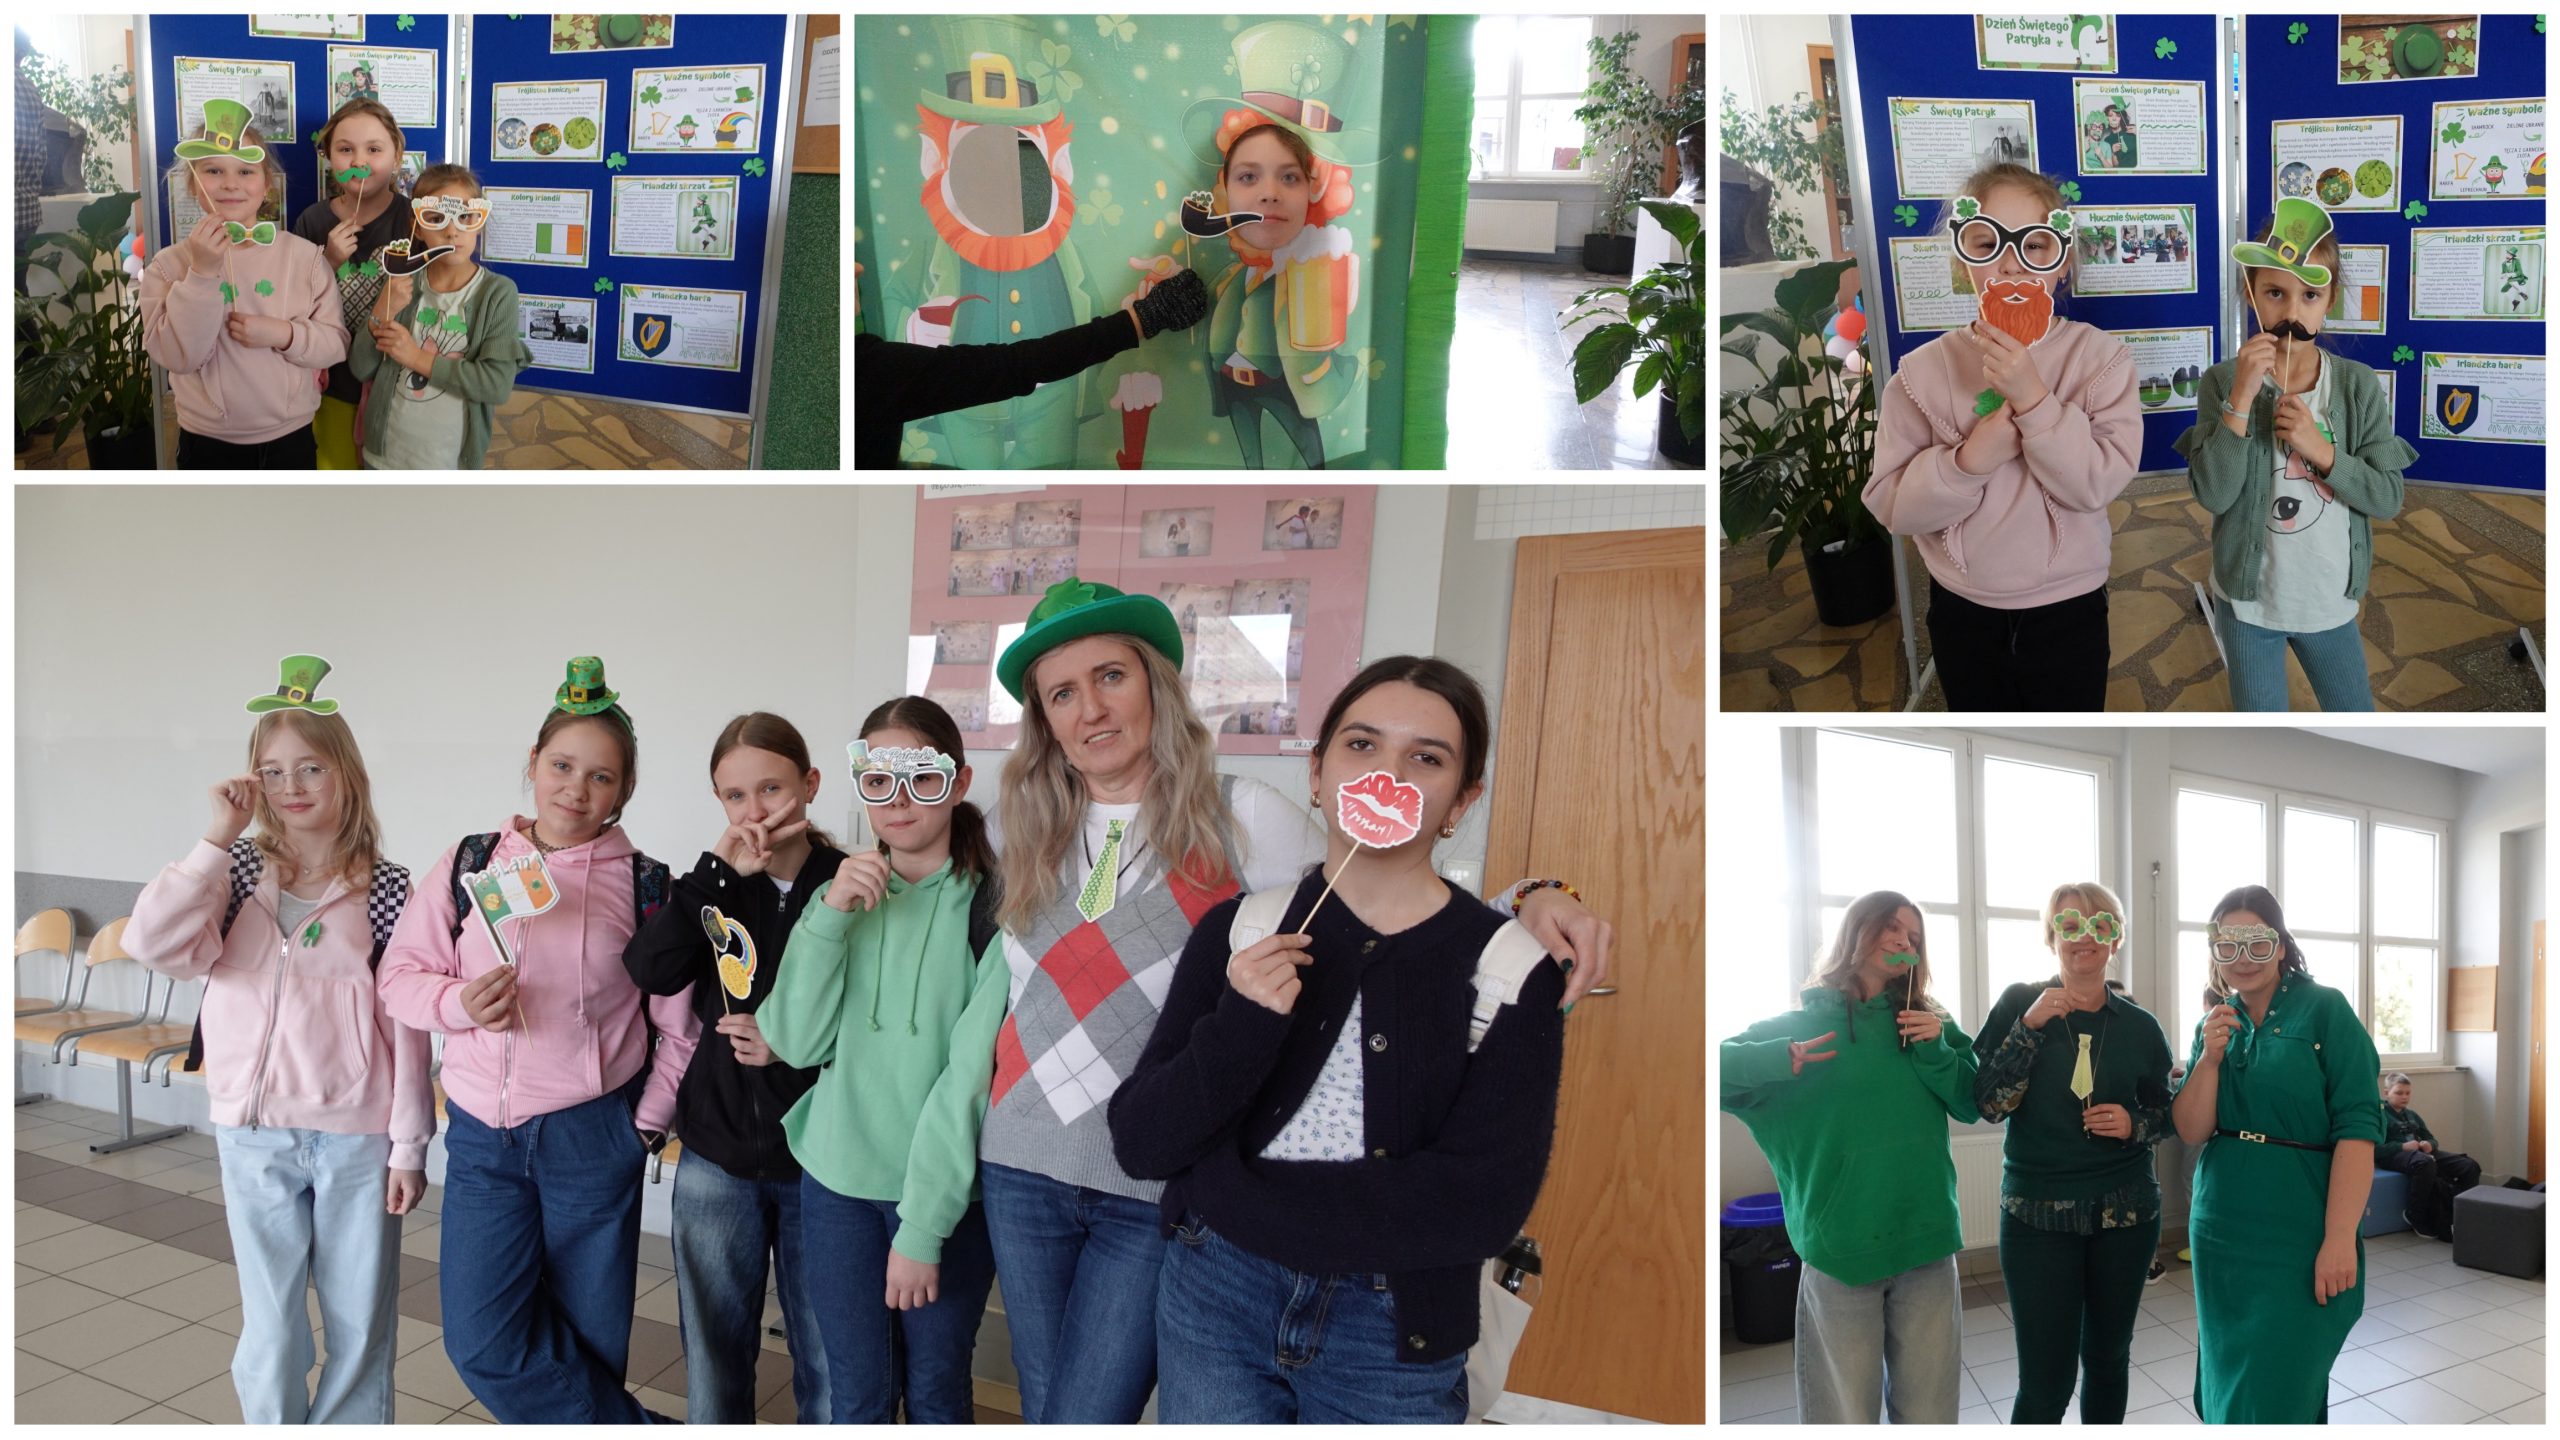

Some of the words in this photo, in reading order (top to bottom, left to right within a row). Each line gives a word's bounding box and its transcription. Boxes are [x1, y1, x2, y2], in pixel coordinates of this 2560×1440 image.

[1985, 17, 2016, 30] Dzień
[2020, 16, 2069, 34] Świętego
[2006, 33, 2051, 47] Patryka
[208, 64, 235, 75] Święty
[236, 65, 262, 76] Patryk
[664, 72, 693, 82] Ważne
[694, 71, 731, 82] symbole
[2100, 86, 2119, 94] Dzień
[2121, 84, 2151, 96] Świętego
[2153, 86, 2180, 96] Patryka
[1931, 104, 1963, 118] Święty
[1965, 106, 1997, 118] Patryk
[2468, 107, 2500, 117] Ważne
[2502, 104, 2543, 117] symbole
[2300, 125, 2335, 134] Trójlistna
[2336, 124, 2373, 133] koniczyna
[679, 182, 706, 190] skrzat
[511, 194, 534, 203] Kolory
[2089, 213, 2124, 222] Hucznie
[2125, 212, 2176, 223] świętowane
[2445, 234, 2484, 243] Irlandzki
[2486, 234, 2516, 243] skrzat
[1913, 243, 1940, 253] Skarb
[2125, 335, 2160, 343] Barwiona
[2161, 334, 2181, 342] woda
[2457, 360, 2496, 369] Irlandzka
[2498, 361, 2522, 370] harfa
[893, 761, 918, 777] Day
